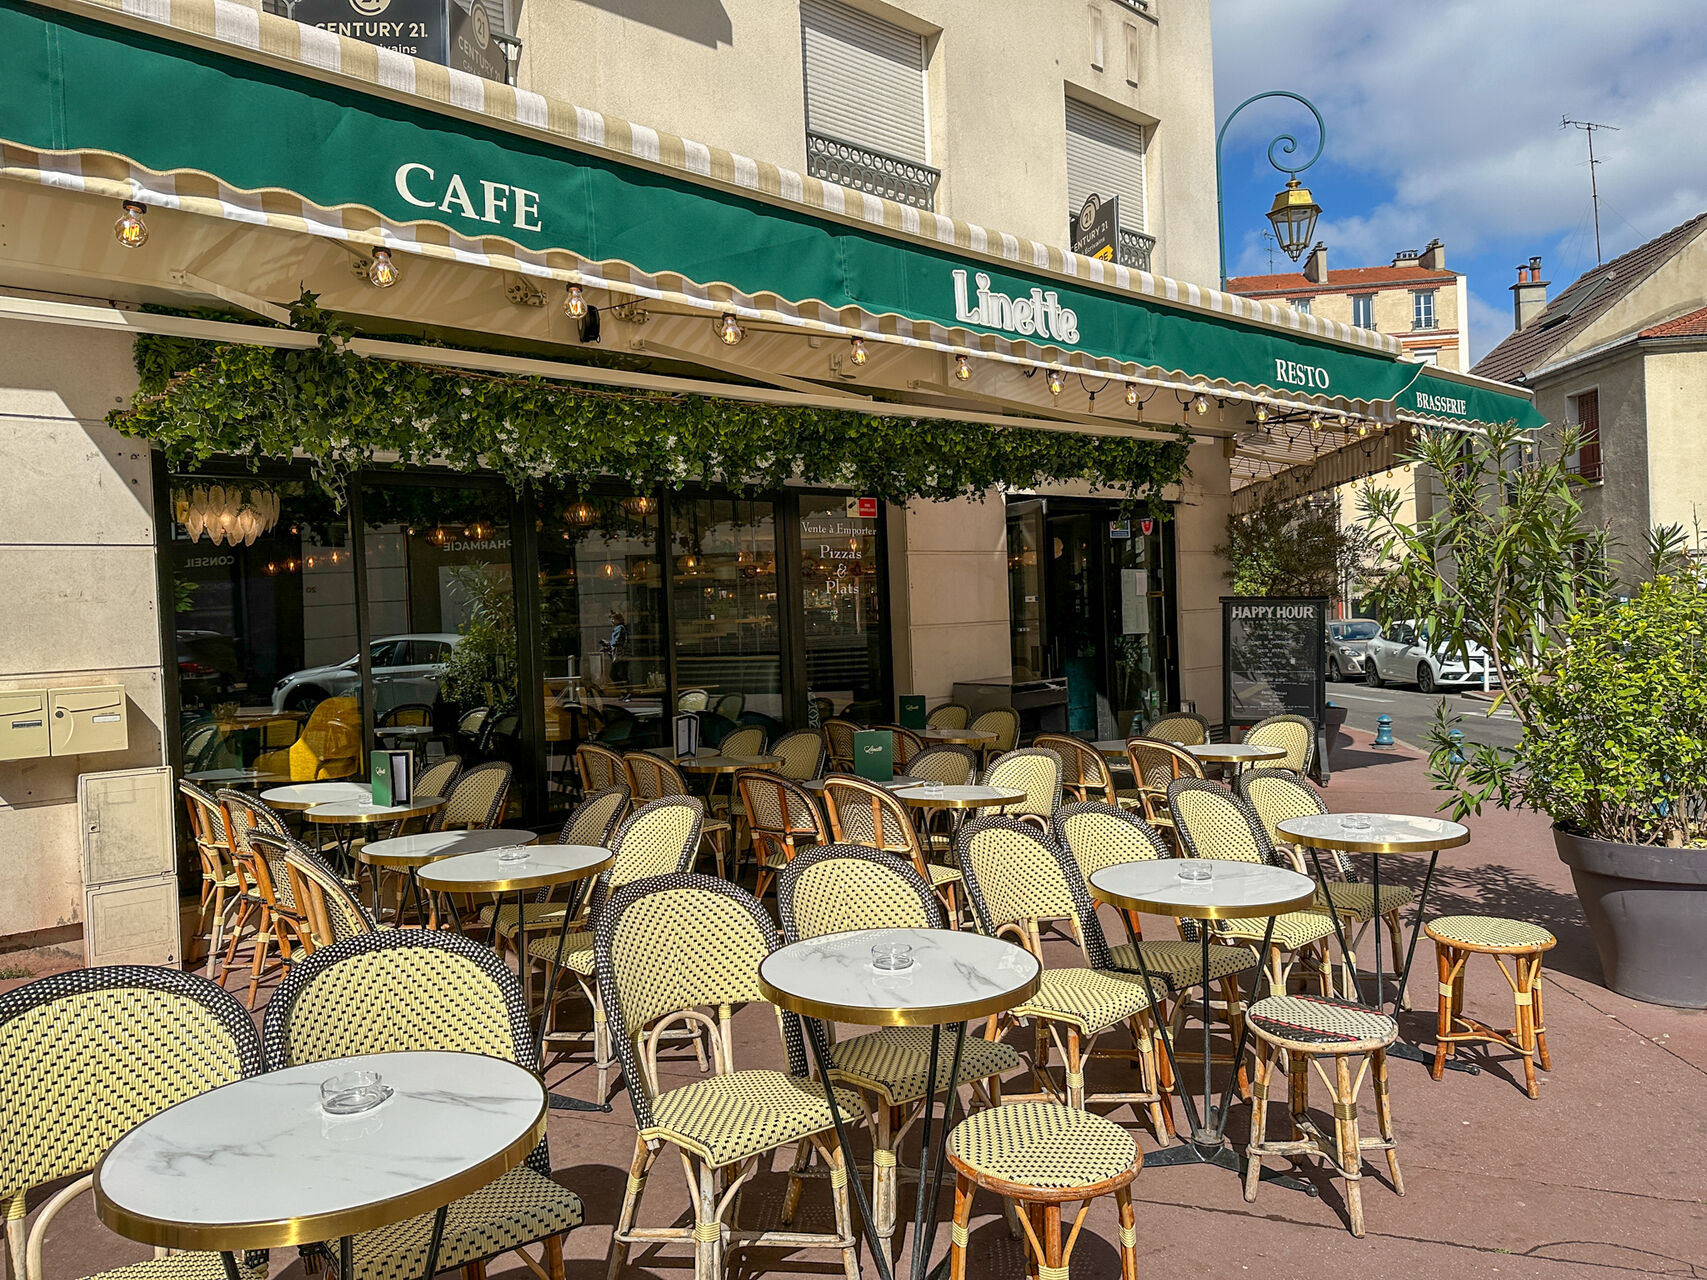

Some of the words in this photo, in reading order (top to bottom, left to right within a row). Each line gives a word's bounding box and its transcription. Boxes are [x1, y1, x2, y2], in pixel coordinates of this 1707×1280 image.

[477, 18, 486, 39] 21
[458, 36, 494, 77] CENTURY
[395, 162, 542, 232] CAFE
[1083, 210, 1092, 224] 21
[1071, 226, 1100, 252] ENTURY
[951, 269, 1080, 344] Linette
[1275, 358, 1330, 389] RESTO
[1415, 391, 1467, 415] BRASSERIE
[801, 521, 827, 533] Vente
[829, 524, 834, 534] à
[836, 522, 877, 537] Emporter
[819, 544, 862, 559] Pizzas
[836, 563, 847, 578] &
[825, 578, 860, 594] Plats
[1231, 606, 1274, 619] HAPPY
[1276, 606, 1314, 619] HOUR
